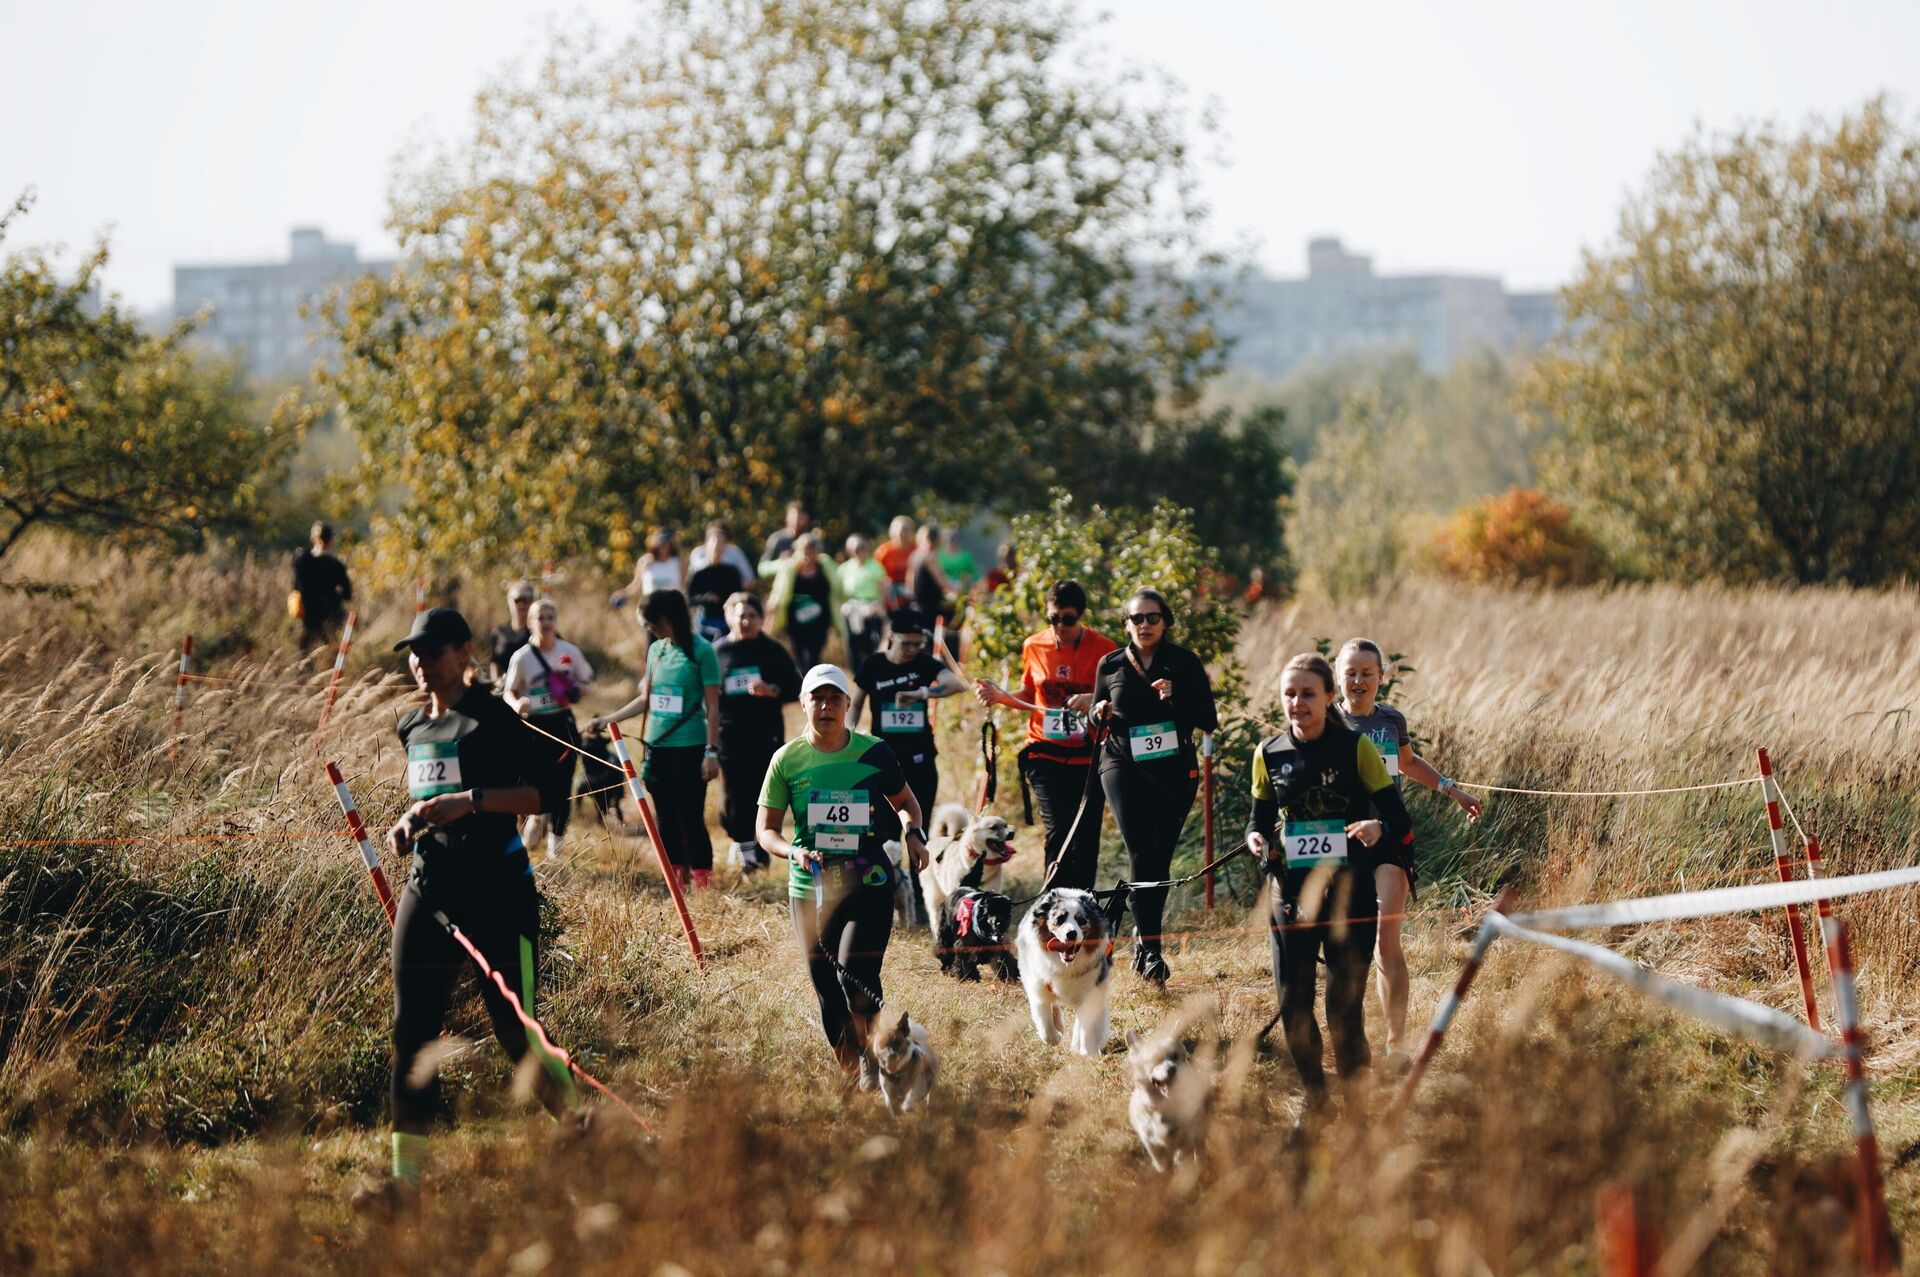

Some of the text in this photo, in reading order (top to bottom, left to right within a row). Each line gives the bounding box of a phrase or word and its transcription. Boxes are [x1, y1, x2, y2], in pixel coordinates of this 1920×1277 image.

[658, 696, 671, 709] 57
[891, 713, 915, 725] 192
[1052, 718, 1078, 732] 25
[1144, 735, 1163, 751] 39
[418, 761, 447, 782] 222
[826, 805, 850, 823] 48
[1297, 836, 1332, 856] 226
